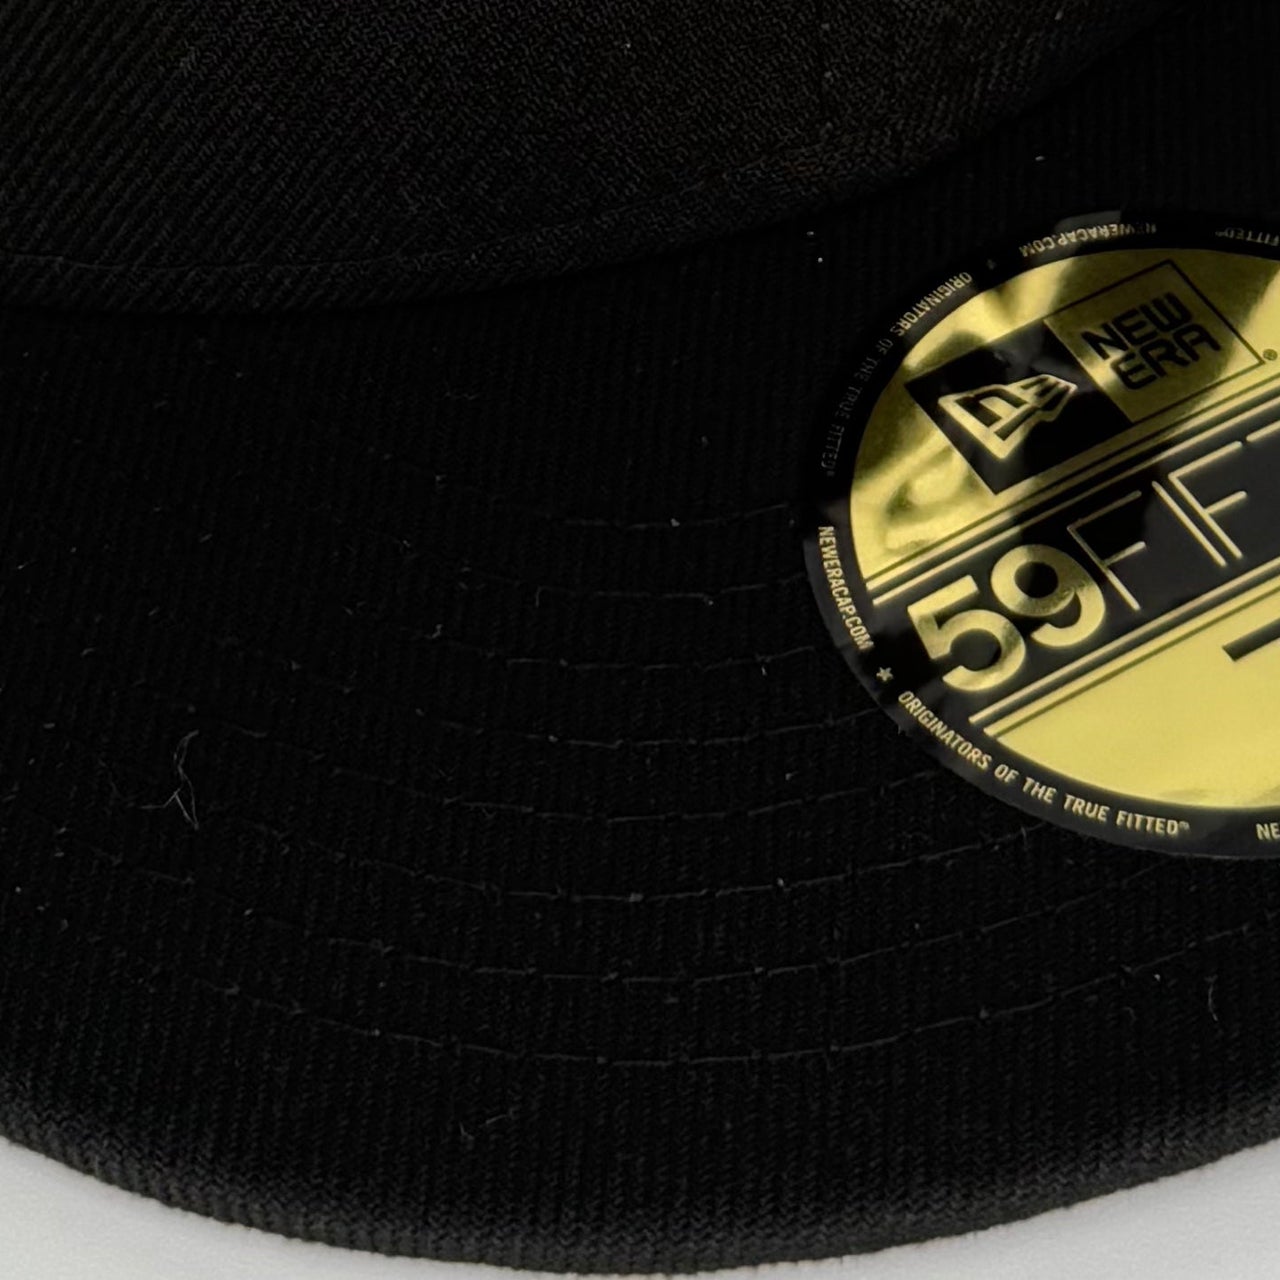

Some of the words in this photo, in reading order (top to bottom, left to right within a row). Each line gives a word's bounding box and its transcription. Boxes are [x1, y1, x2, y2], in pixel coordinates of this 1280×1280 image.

[891, 272, 973, 337] ORIGINATORS
[1081, 292, 1194, 361] NEW
[1111, 325, 1221, 390] ERA
[818, 525, 875, 650] NEWERACAP.COM
[897, 690, 992, 771] ORIGINATORS
[993, 763, 1020, 784] OF
[1022, 776, 1058, 804] THE
[1063, 793, 1111, 823] TRUE
